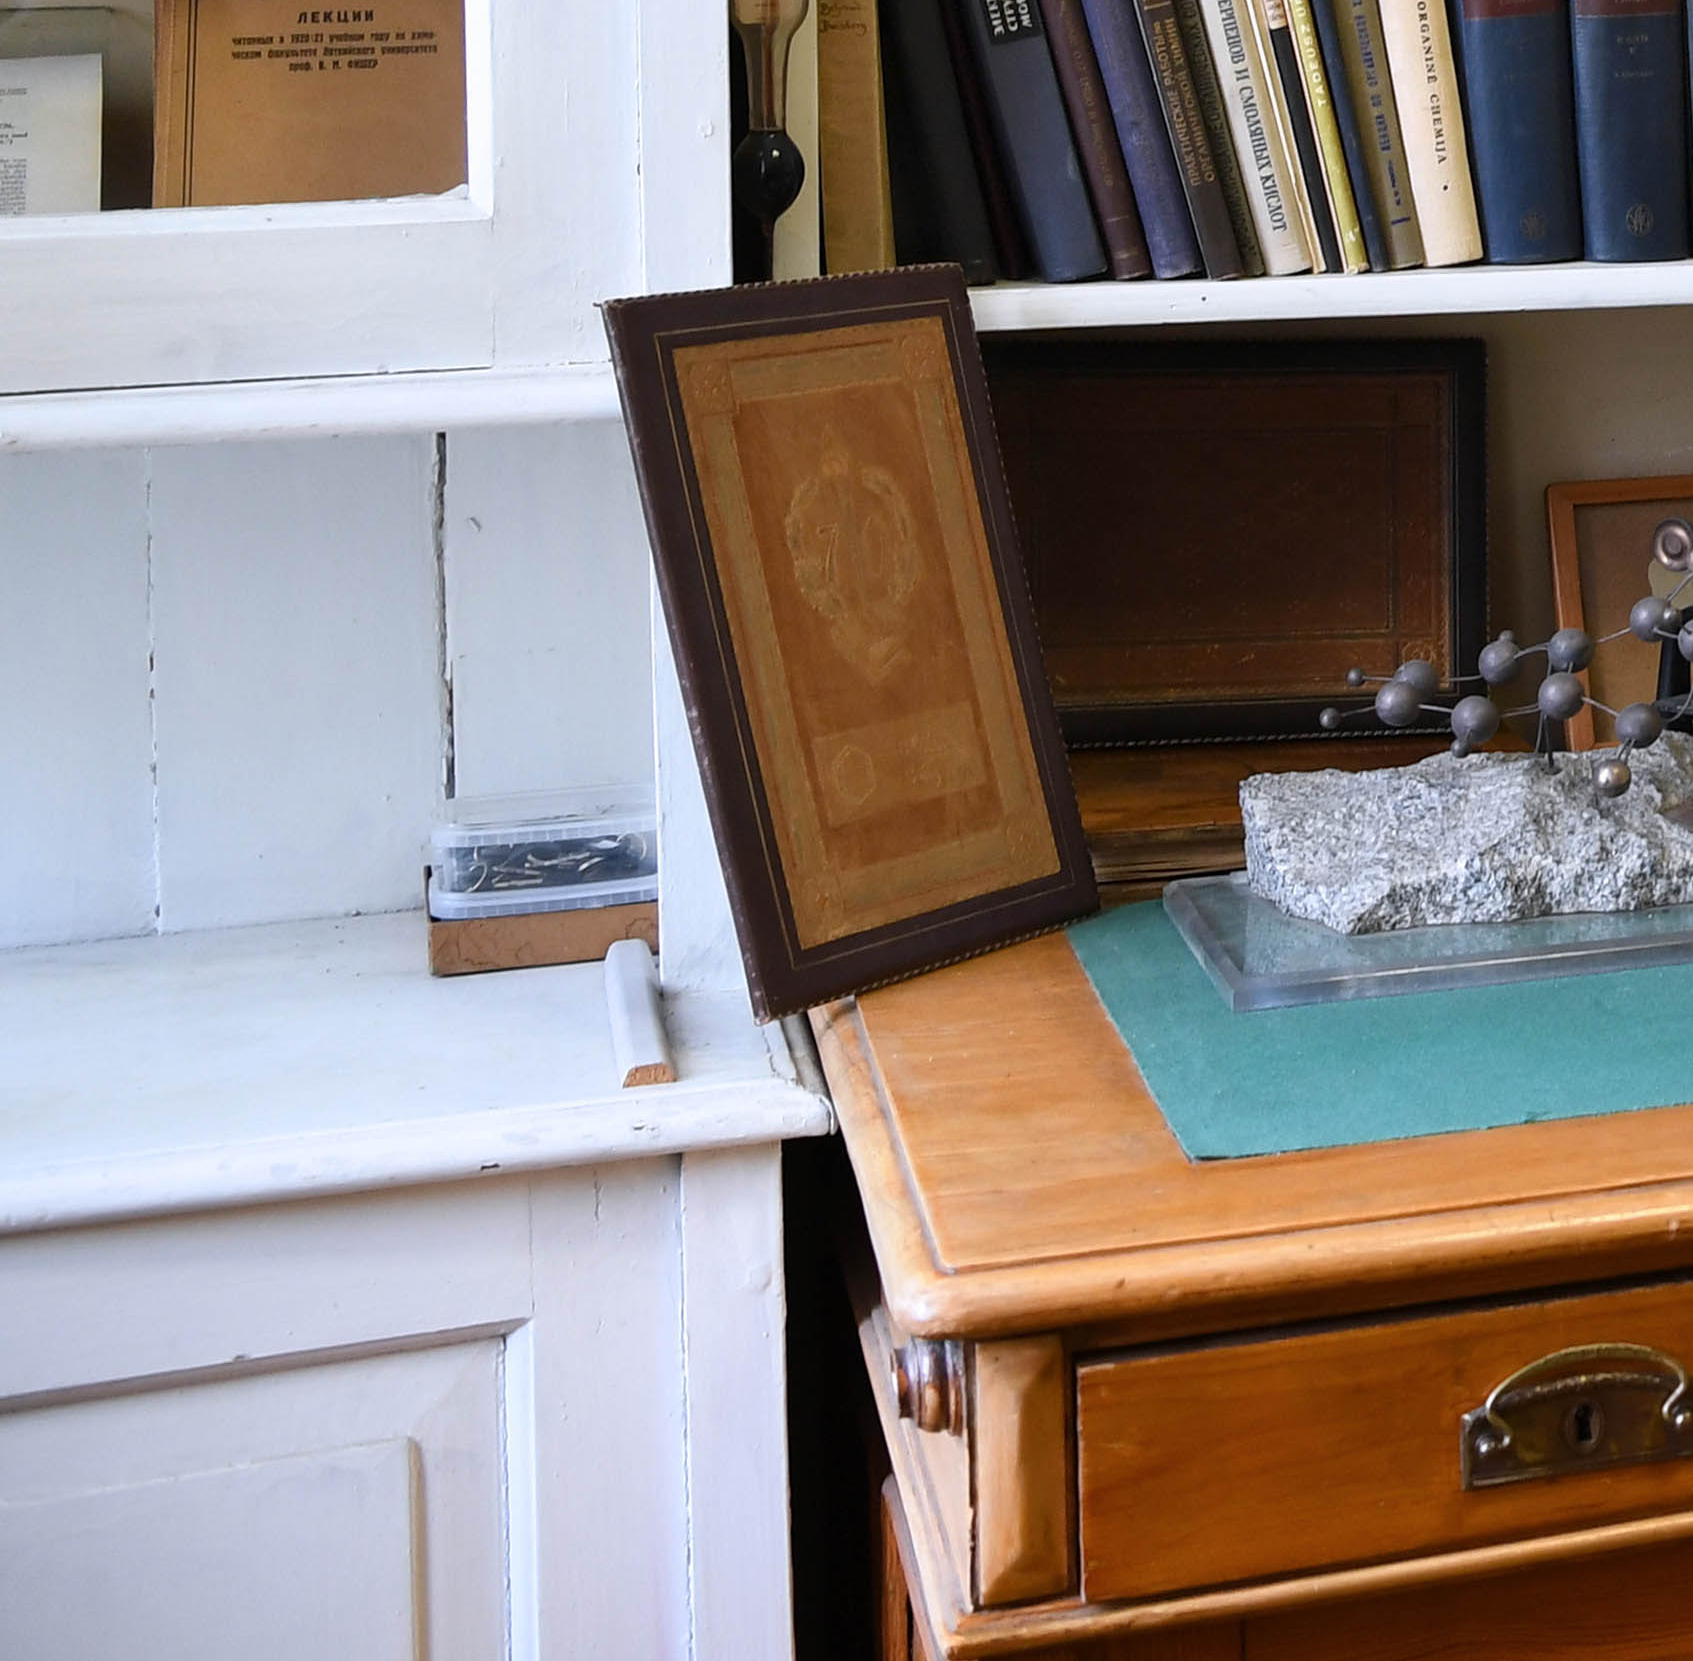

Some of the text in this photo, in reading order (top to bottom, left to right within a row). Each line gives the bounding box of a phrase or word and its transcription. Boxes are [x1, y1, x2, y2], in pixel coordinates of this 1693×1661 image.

[298, 10, 374, 24] ЛЕКЦИИ
[1164, 18, 1184, 66] ХИМИИ
[1234, 68, 1249, 81] И
[1300, 24, 1327, 107] TADEUSZ
[1166, 89, 1199, 186] ПРАКТИЧЕСКИЕ
[1239, 86, 1272, 174] СМОЛЯНЫХ
[1430, 93, 1447, 164] CHEMIJA
[1260, 173, 1287, 232] КИСЛОТ
